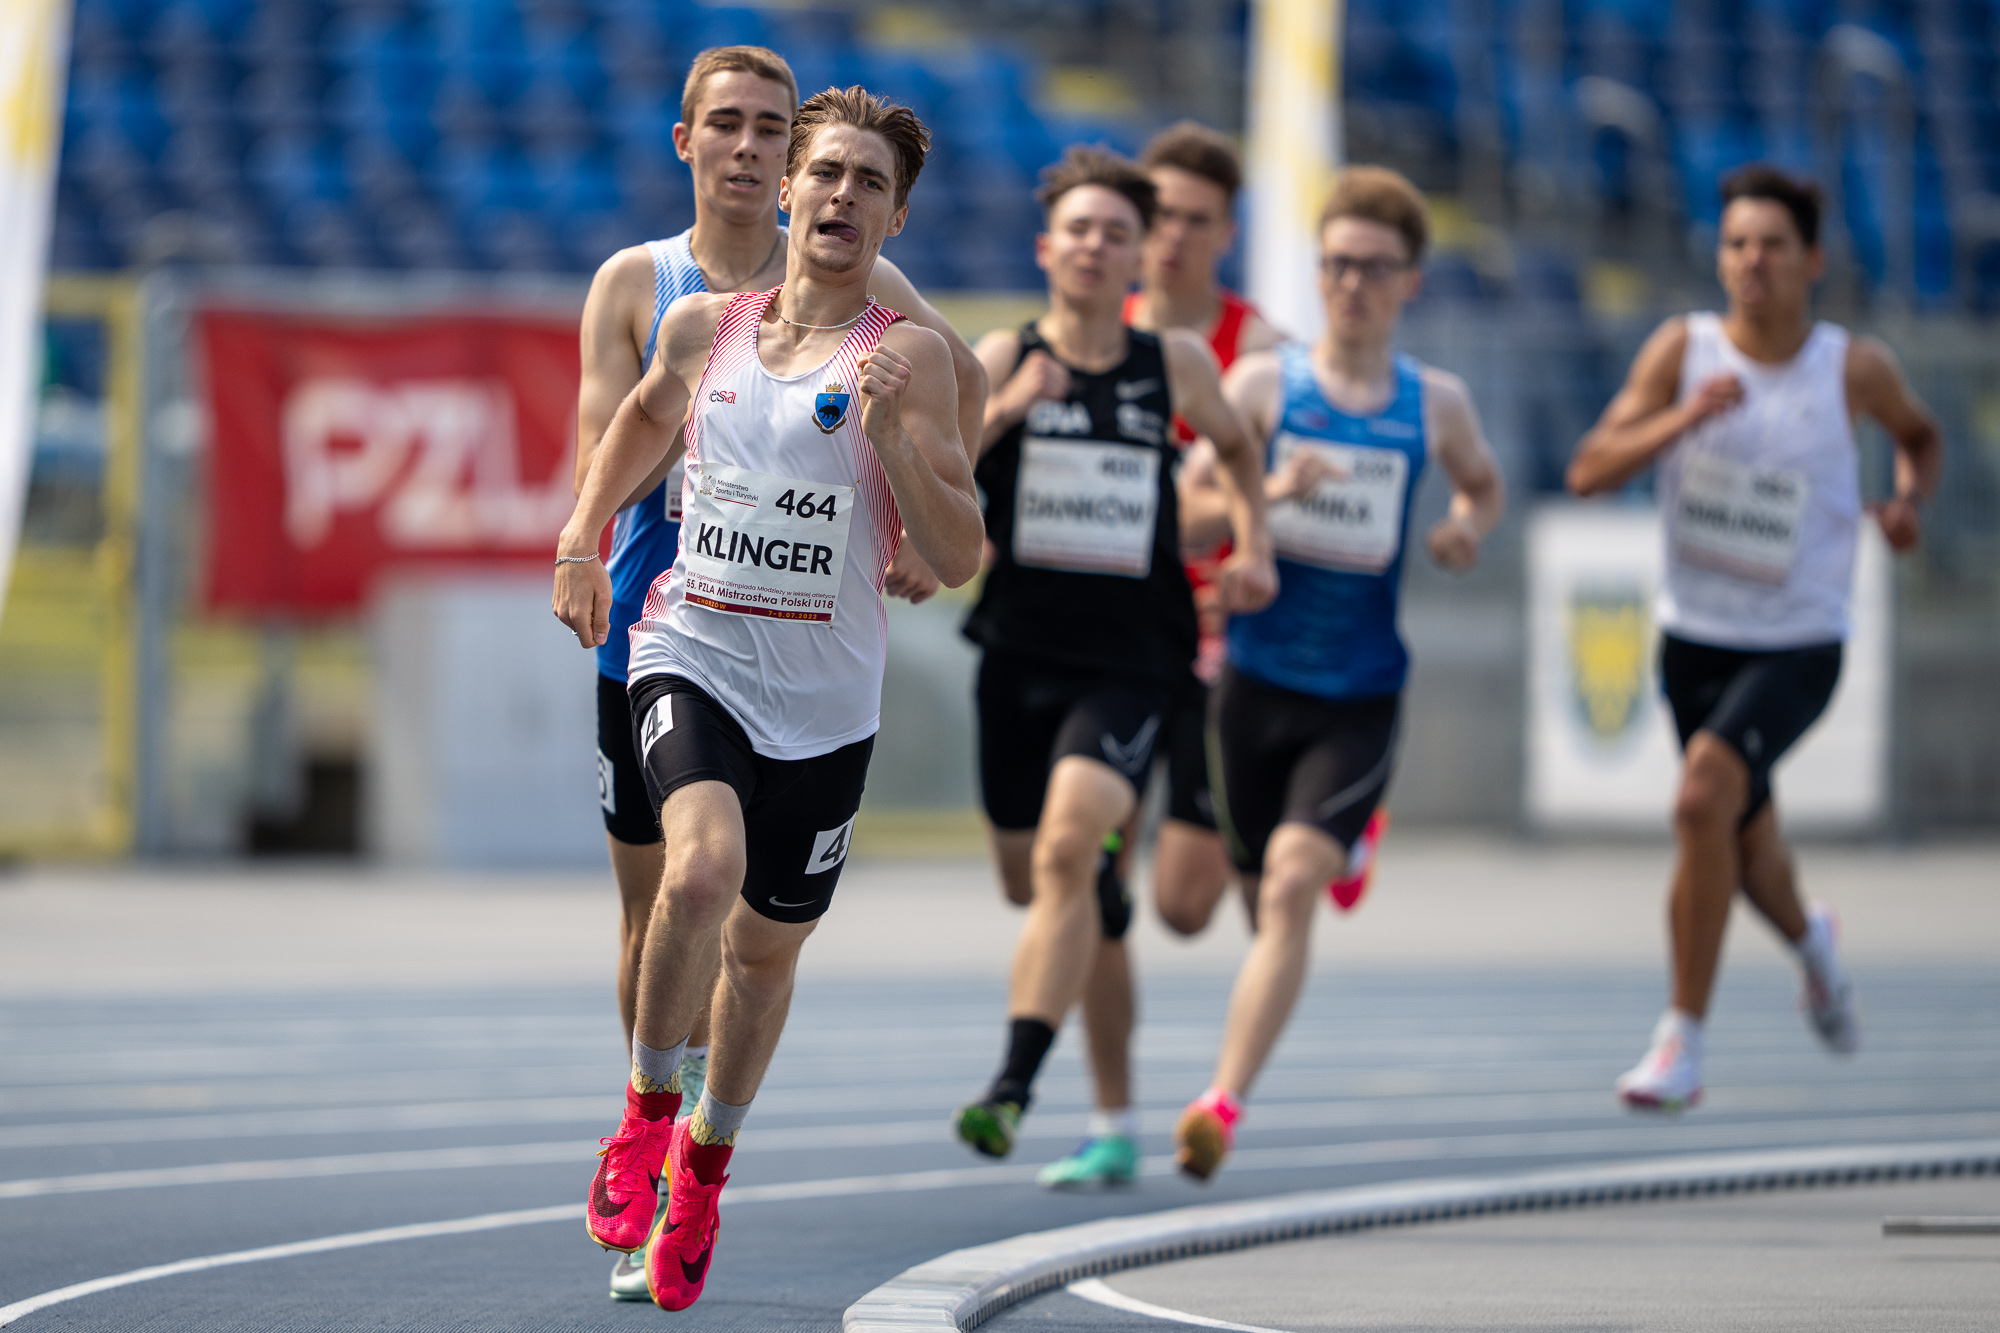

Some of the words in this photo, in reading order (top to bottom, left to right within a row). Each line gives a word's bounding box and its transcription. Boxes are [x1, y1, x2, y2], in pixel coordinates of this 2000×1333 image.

[279, 376, 577, 551] PZL
[715, 486, 732, 496] Sportu
[735, 490, 759, 502] Turystyki
[717, 479, 749, 492] Ministerstwo
[775, 488, 837, 522] 464
[696, 522, 833, 576] KLINGER
[686, 578, 697, 590] 55.
[698, 581, 715, 595] PZLA
[716, 586, 778, 605] Mistrzostwa
[780, 597, 812, 608] Polski
[814, 599, 834, 609] U18
[696, 572, 725, 586] Ogólnopolska
[725, 580, 757, 591] Olimpiada
[757, 585, 786, 597] Młodzieży
[792, 590, 812, 599] lekkiej
[644, 703, 664, 749] 4
[819, 823, 849, 864] 4
